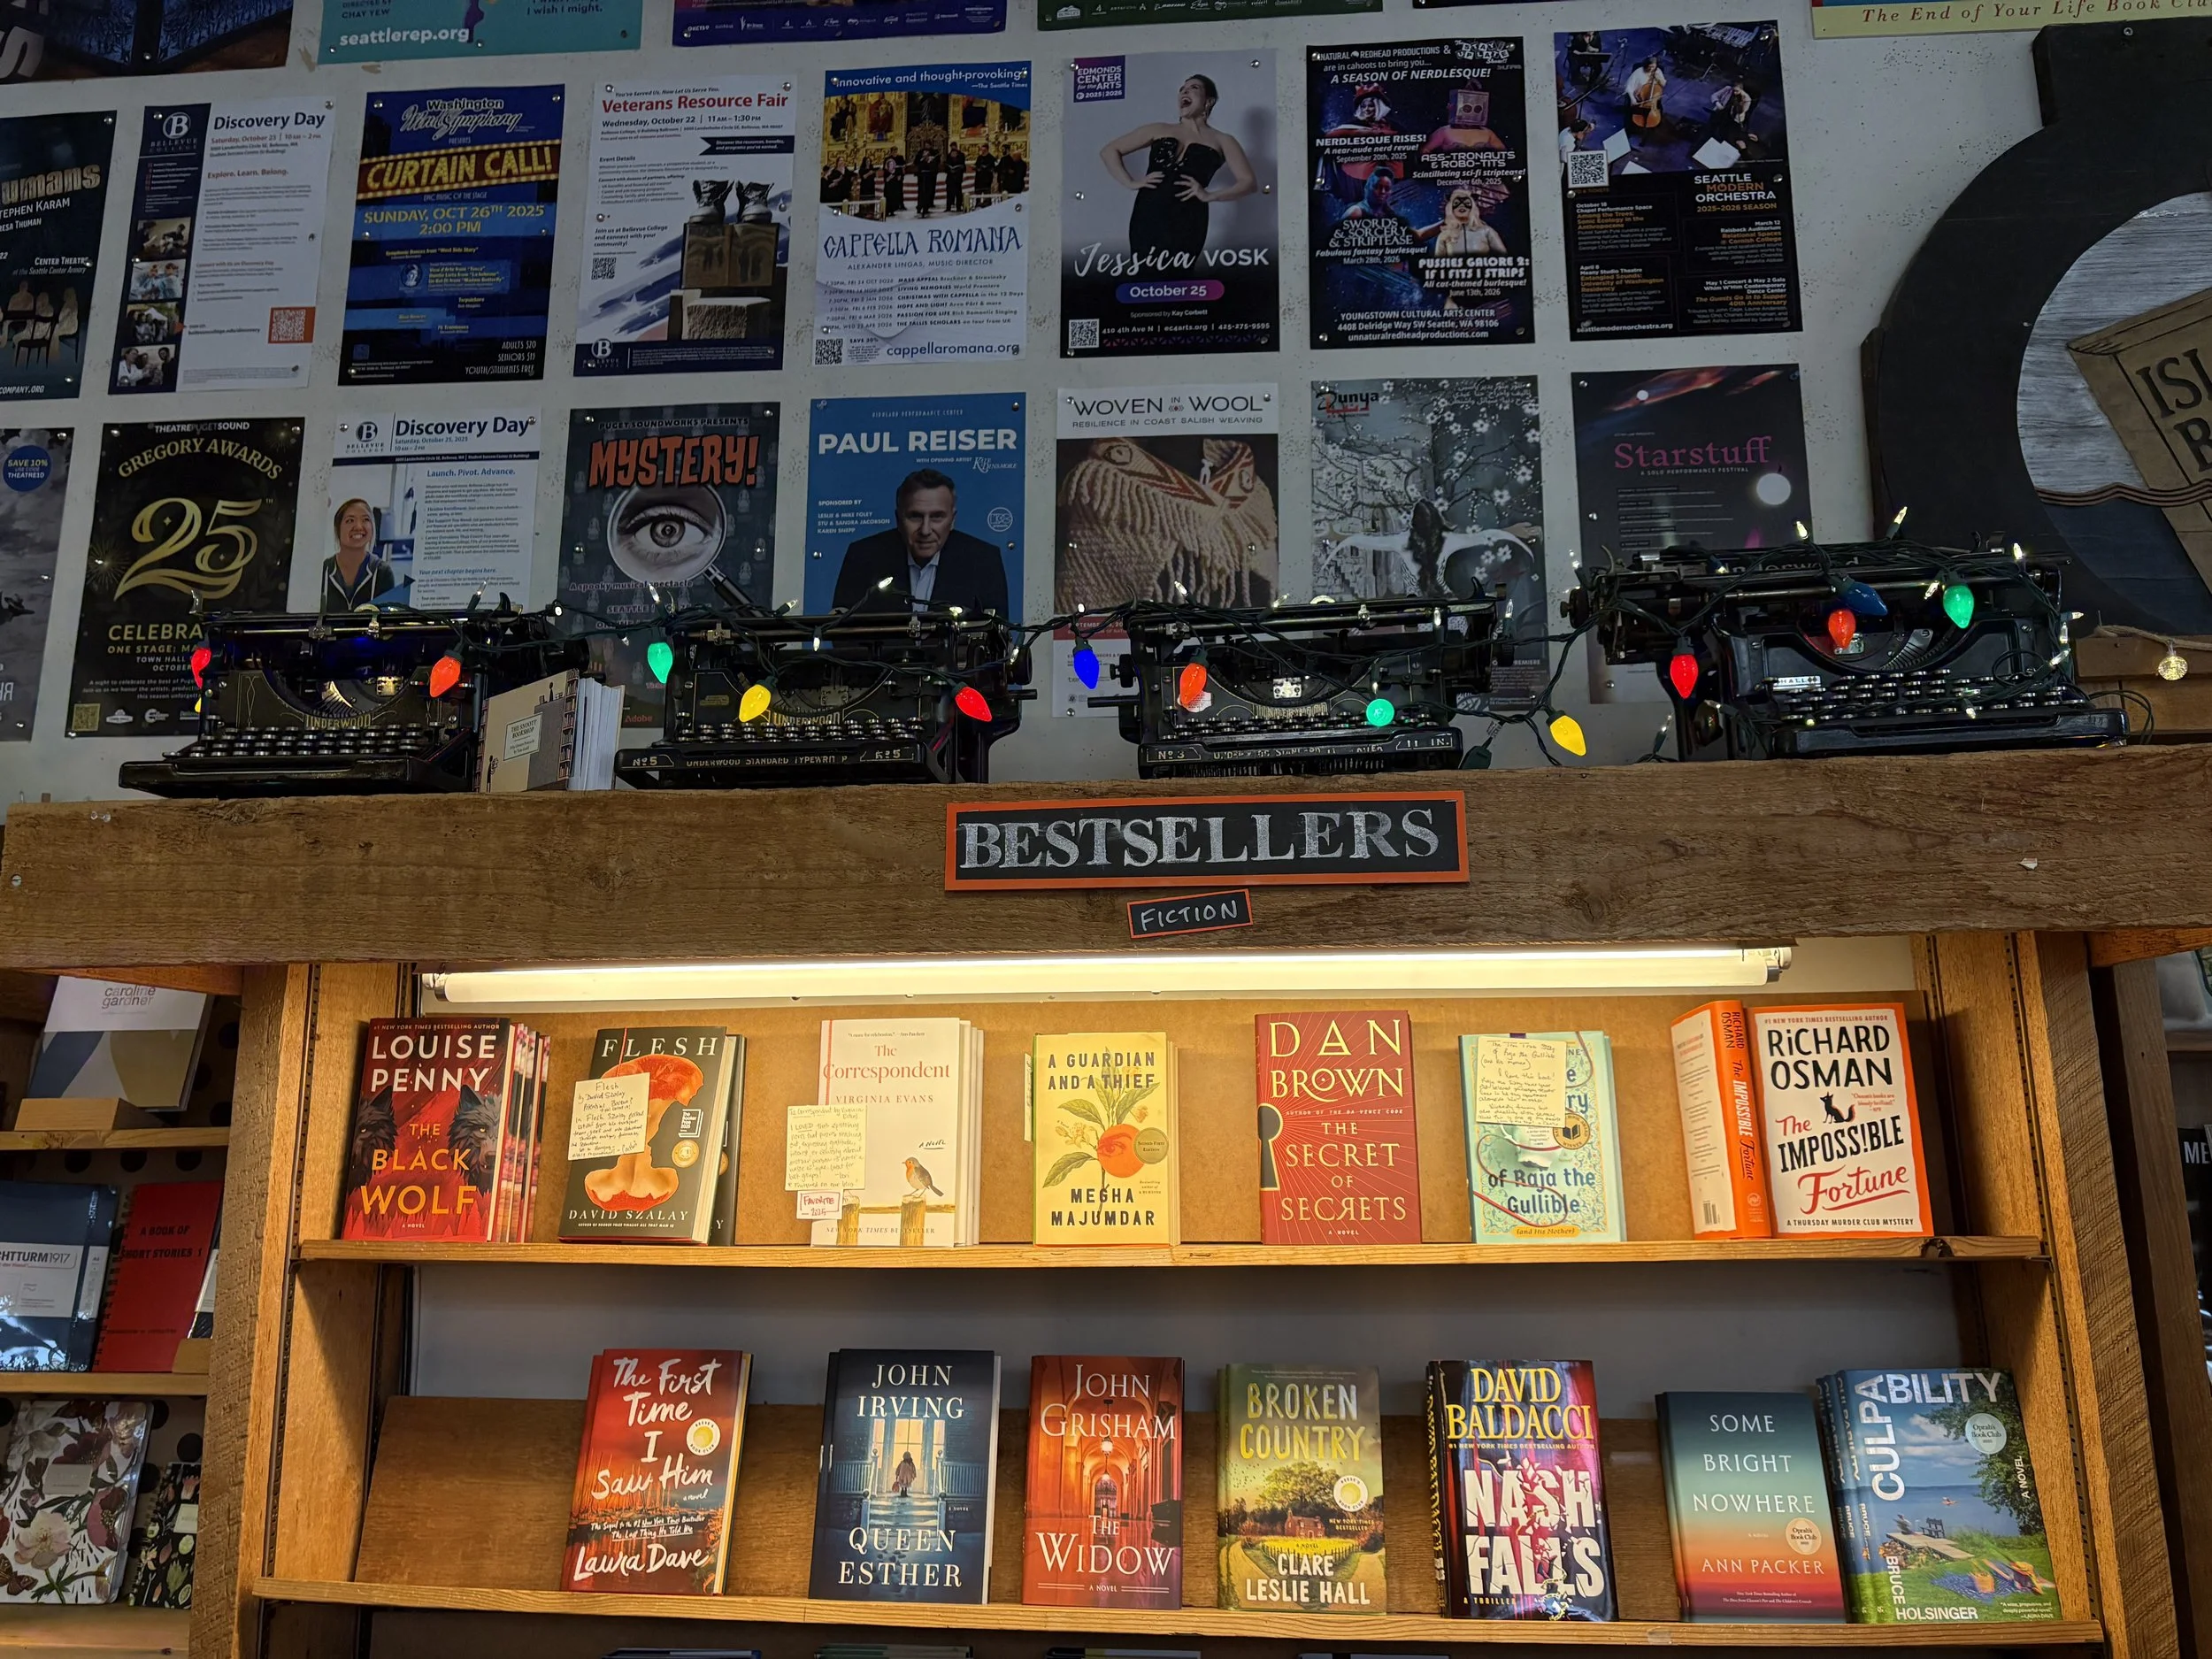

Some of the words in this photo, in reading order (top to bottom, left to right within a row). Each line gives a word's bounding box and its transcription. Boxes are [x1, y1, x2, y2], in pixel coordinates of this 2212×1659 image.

[1863, 9, 1899, 23] The
[1910, 6, 1950, 20] End
[1961, 4, 1985, 23] of
[1993, 3, 2041, 17] Your
[2053, 0, 2094, 15] Life
[340, 27, 470, 46] seattlerep.org
[1360, 50, 1391, 59] REDHEAD
[1393, 46, 1440, 57] PRODUCTIONS
[895, 71, 917, 83] and
[1077, 65, 1122, 76] EDMONDS
[1077, 73, 1121, 84] CENTER
[1341, 72, 1388, 83] SEASON
[1391, 70, 1408, 81] OF
[1410, 67, 1492, 81] NERDLESQUE!
[426, 98, 504, 111] Washington
[602, 99, 673, 113] Veterans
[678, 95, 752, 110] Resource
[757, 93, 788, 107] Fair
[214, 114, 290, 130] Discovery
[295, 112, 326, 128] Day
[602, 118, 649, 129] Wednesday,
[651, 116, 684, 127] October
[1316, 135, 1392, 148] NERDLESQUE
[1393, 134, 1426, 144] RISES!
[1421, 151, 1516, 163] ASS-TRONAUTS
[366, 152, 477, 190] CURTAIN
[484, 146, 553, 179] CALL!
[1694, 173, 1752, 184] SEATTLE
[1706, 182, 1764, 192] MODERN
[1695, 191, 1777, 204] ORCHESTRA
[364, 206, 429, 224] SUNDAY,
[433, 206, 465, 220] OCT
[507, 204, 545, 217] 2025
[1343, 218, 1399, 230] SWORDS
[419, 222, 453, 236] 2:00
[457, 221, 481, 234] PM
[823, 231, 919, 259] CAPPELLA
[927, 226, 1023, 254] ROMANA
[1344, 235, 1415, 248] STRIPTEASE
[1074, 242, 1196, 278] Jessica
[1203, 249, 1270, 267] VOSK
[1418, 257, 1463, 269] PUSSIES
[1466, 257, 1514, 267] GALORE
[1130, 286, 1187, 299] October
[1190, 285, 1207, 297] 25
[1340, 310, 1399, 321] YOUNGSTOWN
[1401, 310, 1442, 319] CULTURAL
[1348, 330, 1488, 342] unnaturalredheadproductions.com
[1577, 322, 1674, 334] seattlemodernorchestra.org
[887, 342, 1020, 358] cappellaromana.org
[1073, 397, 1163, 416] WOVEN
[1189, 396, 1263, 412] WOOL
[396, 419, 488, 437] Discovery
[493, 417, 529, 436] Day
[1073, 419, 1125, 428] RESILIENCE
[818, 432, 899, 455] PAUL
[908, 429, 1018, 452] REISER
[1614, 435, 1772, 469] Starstuff
[118, 437, 205, 479] GREGORY
[206, 437, 283, 481] AWARDS
[588, 434, 760, 488] MYSTERY!
[958, 809, 1440, 872] BESTSELLERS
[1140, 900, 1239, 932] FICTION
[104, 984, 156, 998] caroline
[102, 995, 154, 1010] gardner
[371, 1035, 497, 1060] LOUISE
[602, 1037, 718, 1058] FLESH
[1270, 1019, 1401, 1057] DAN
[874, 1045, 898, 1057] The
[1048, 1055, 1056, 1069] A
[1067, 1052, 1156, 1069] GUARDIAN
[370, 1067, 490, 1093] PENNY
[823, 1061, 950, 1084] Correspondent
[1048, 1075, 1080, 1090] AND
[1102, 1074, 1155, 1089] THIEF
[1770, 1057, 1893, 1090] OSMAN
[1271, 1068, 1404, 1102] BROWN
[896, 1094, 935, 1103] EVANS
[409, 1124, 442, 1136] THE
[1322, 1122, 1359, 1135] THE
[1775, 1115, 1813, 1137] The
[371, 1148, 472, 1171] BLACK
[1286, 1143, 1401, 1168] SECRET
[1332, 1175, 1354, 1189] OF
[1488, 1168, 1508, 1189] of
[1512, 1170, 1557, 1193] Raja
[1563, 1168, 1595, 1187] the
[1798, 1164, 1910, 1216] Fortune
[360, 1185, 478, 1215] WOLF
[803, 1195, 835, 1205] FAVORITE
[1071, 1188, 1134, 1204] MEGHA
[1507, 1194, 1581, 1215] Gullible
[569, 1210, 618, 1220] DAVID
[626, 1210, 689, 1222] SZALAY
[1051, 1210, 1156, 1226] MAJUMDAR
[1882, 1217, 1915, 1225] MYSTERY
[152, 1248, 193, 1259] STORIES
[613, 1356, 652, 1388] The
[657, 1358, 723, 1395] First
[872, 1364, 953, 1389] JOHN
[1074, 1363, 1150, 1401] JOHN
[1471, 1368, 1563, 1403] DAVID
[623, 1391, 693, 1427] Time
[856, 1395, 964, 1420] IRVING
[1247, 1383, 1358, 1421] BROKEN
[1041, 1403, 1176, 1440] GRISHAM
[1446, 1404, 1595, 1441] BALDACCI
[1709, 1414, 1776, 1433] SOME
[641, 1431, 663, 1463] I
[1240, 1424, 1366, 1462] COUNTRY
[1703, 1454, 1793, 1473] BRIGHT
[591, 1469, 653, 1501] Saw
[658, 1452, 713, 1490] Him
[1464, 1468, 1596, 1529] NASH
[1693, 1493, 1816, 1514] NOWHERE
[1088, 1514, 1121, 1536] THE
[849, 1526, 956, 1555] QUEEN
[573, 1546, 646, 1582] Laura
[647, 1543, 710, 1574] Dave
[1035, 1532, 1175, 1577] WIDOW
[838, 1561, 963, 1588] ESTHER
[1277, 1553, 1335, 1578] CLARE
[1465, 1534, 1605, 1598] FALLS
[1701, 1558, 1743, 1573] ANN
[1751, 1558, 1825, 1576] PACKER
[1886, 1555, 1906, 1604] BRUCE
[1246, 1578, 1310, 1603] LESLIE
[1319, 1581, 1371, 1606] HALL
[1895, 1606, 1978, 1621] HOLSINGER
